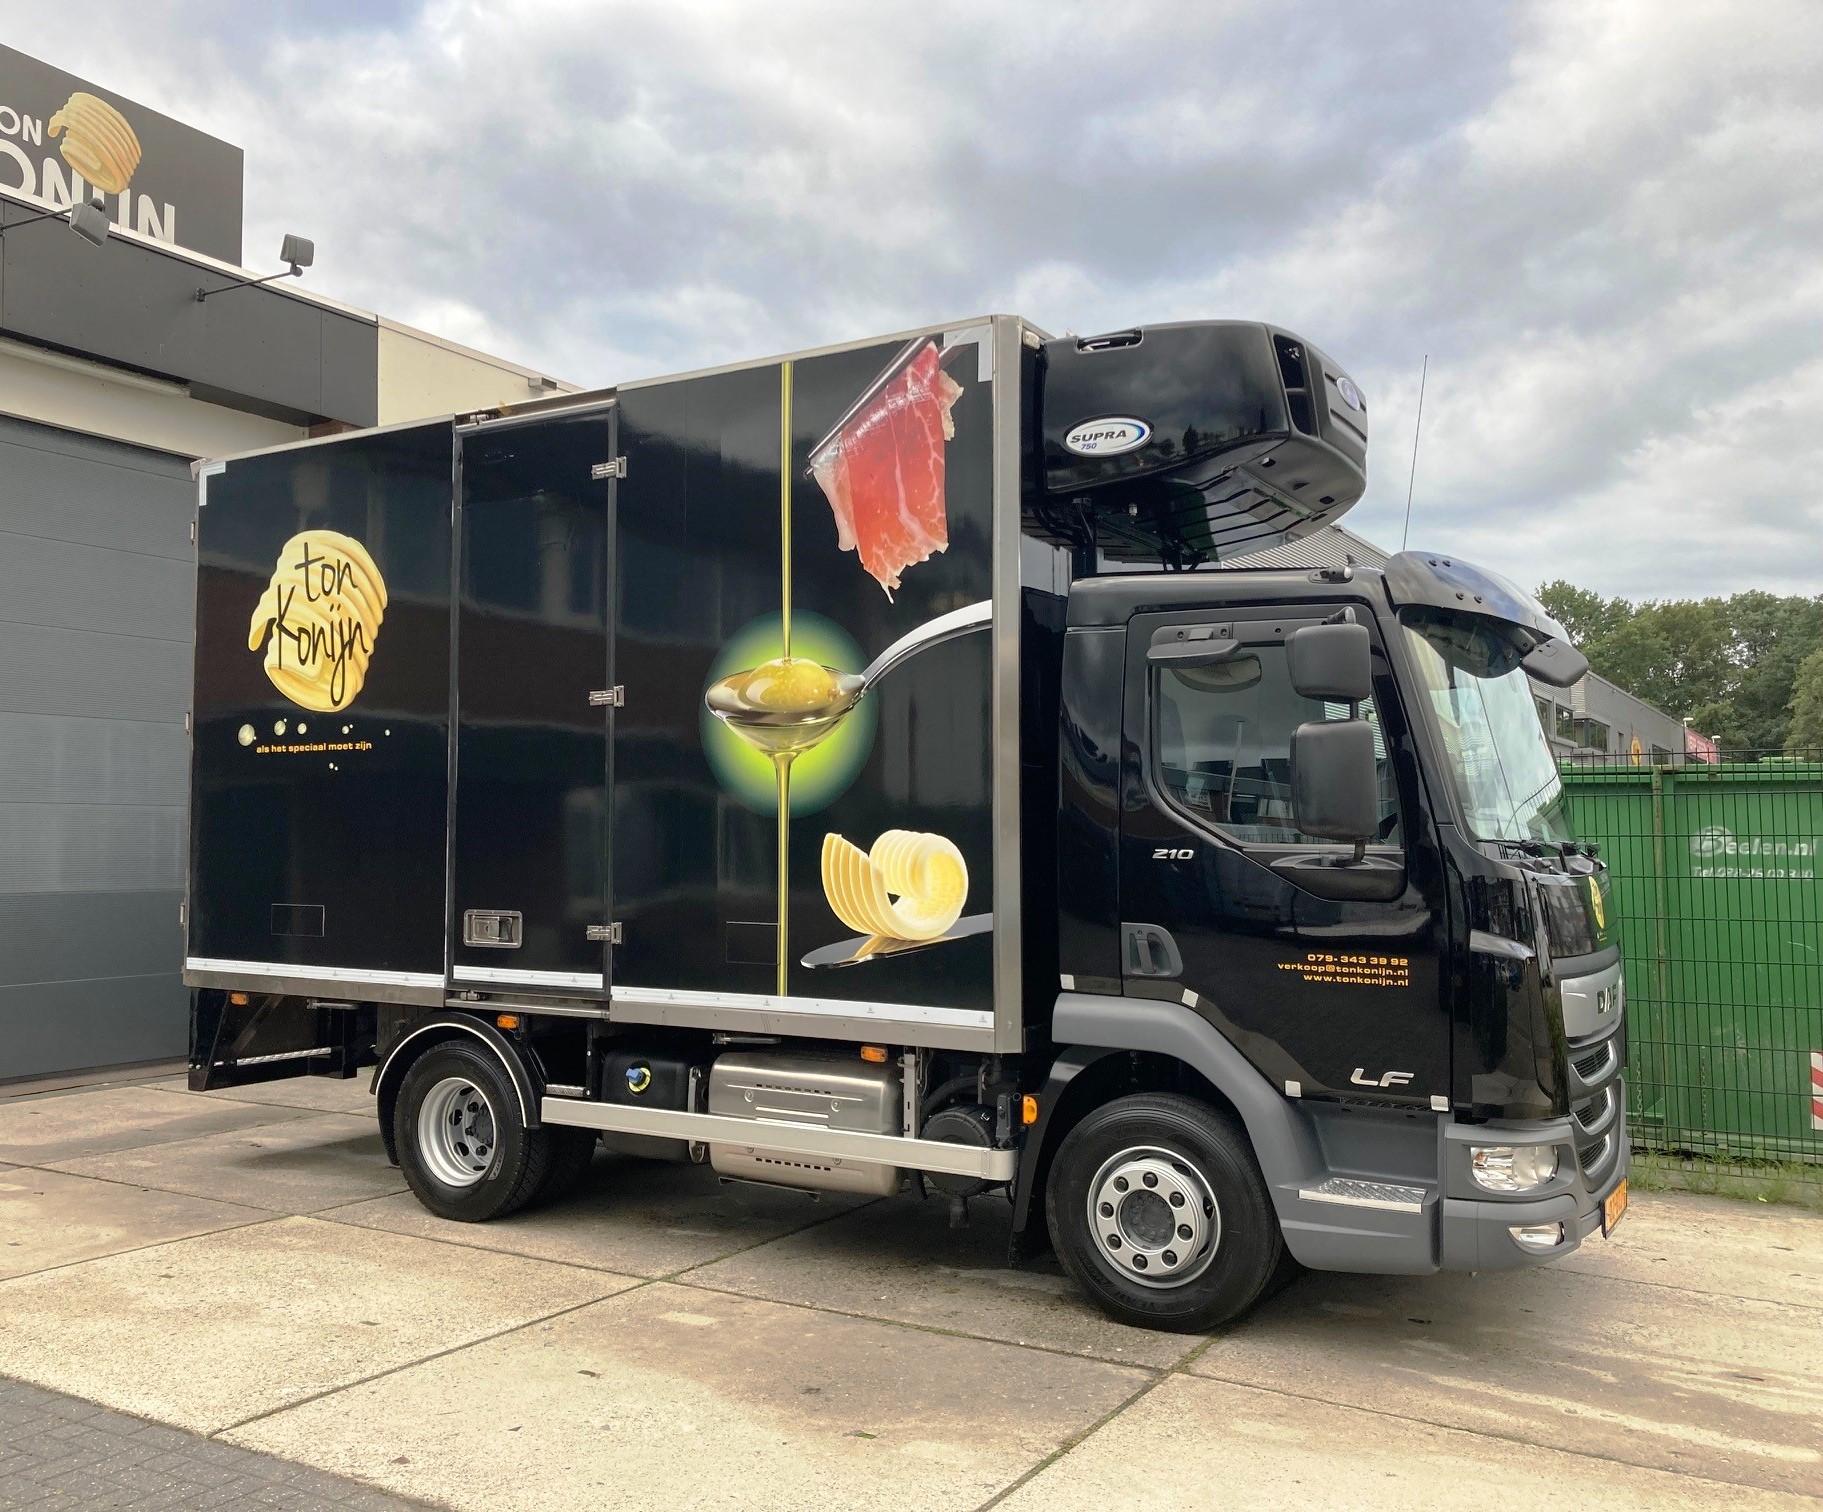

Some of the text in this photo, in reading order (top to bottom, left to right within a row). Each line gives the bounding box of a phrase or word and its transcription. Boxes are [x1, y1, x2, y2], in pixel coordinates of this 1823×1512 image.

[1070, 429, 1127, 443] SUPRA
[1081, 442, 1098, 450] 750
[294, 541, 359, 602] ton
[273, 584, 369, 706] Konijn
[256, 741, 373, 754] als het speciaal moet zijn
[1152, 848, 1195, 860] 210
[1340, 955, 1367, 964] 343
[1390, 958, 1409, 966] 92
[1277, 963, 1409, 976] verkoop@tonkonijn.nl
[1303, 974, 1409, 986] www.tonkonijn.nl
[1596, 983, 1617, 1014] DAF
[1350, 1067, 1415, 1088] LF
